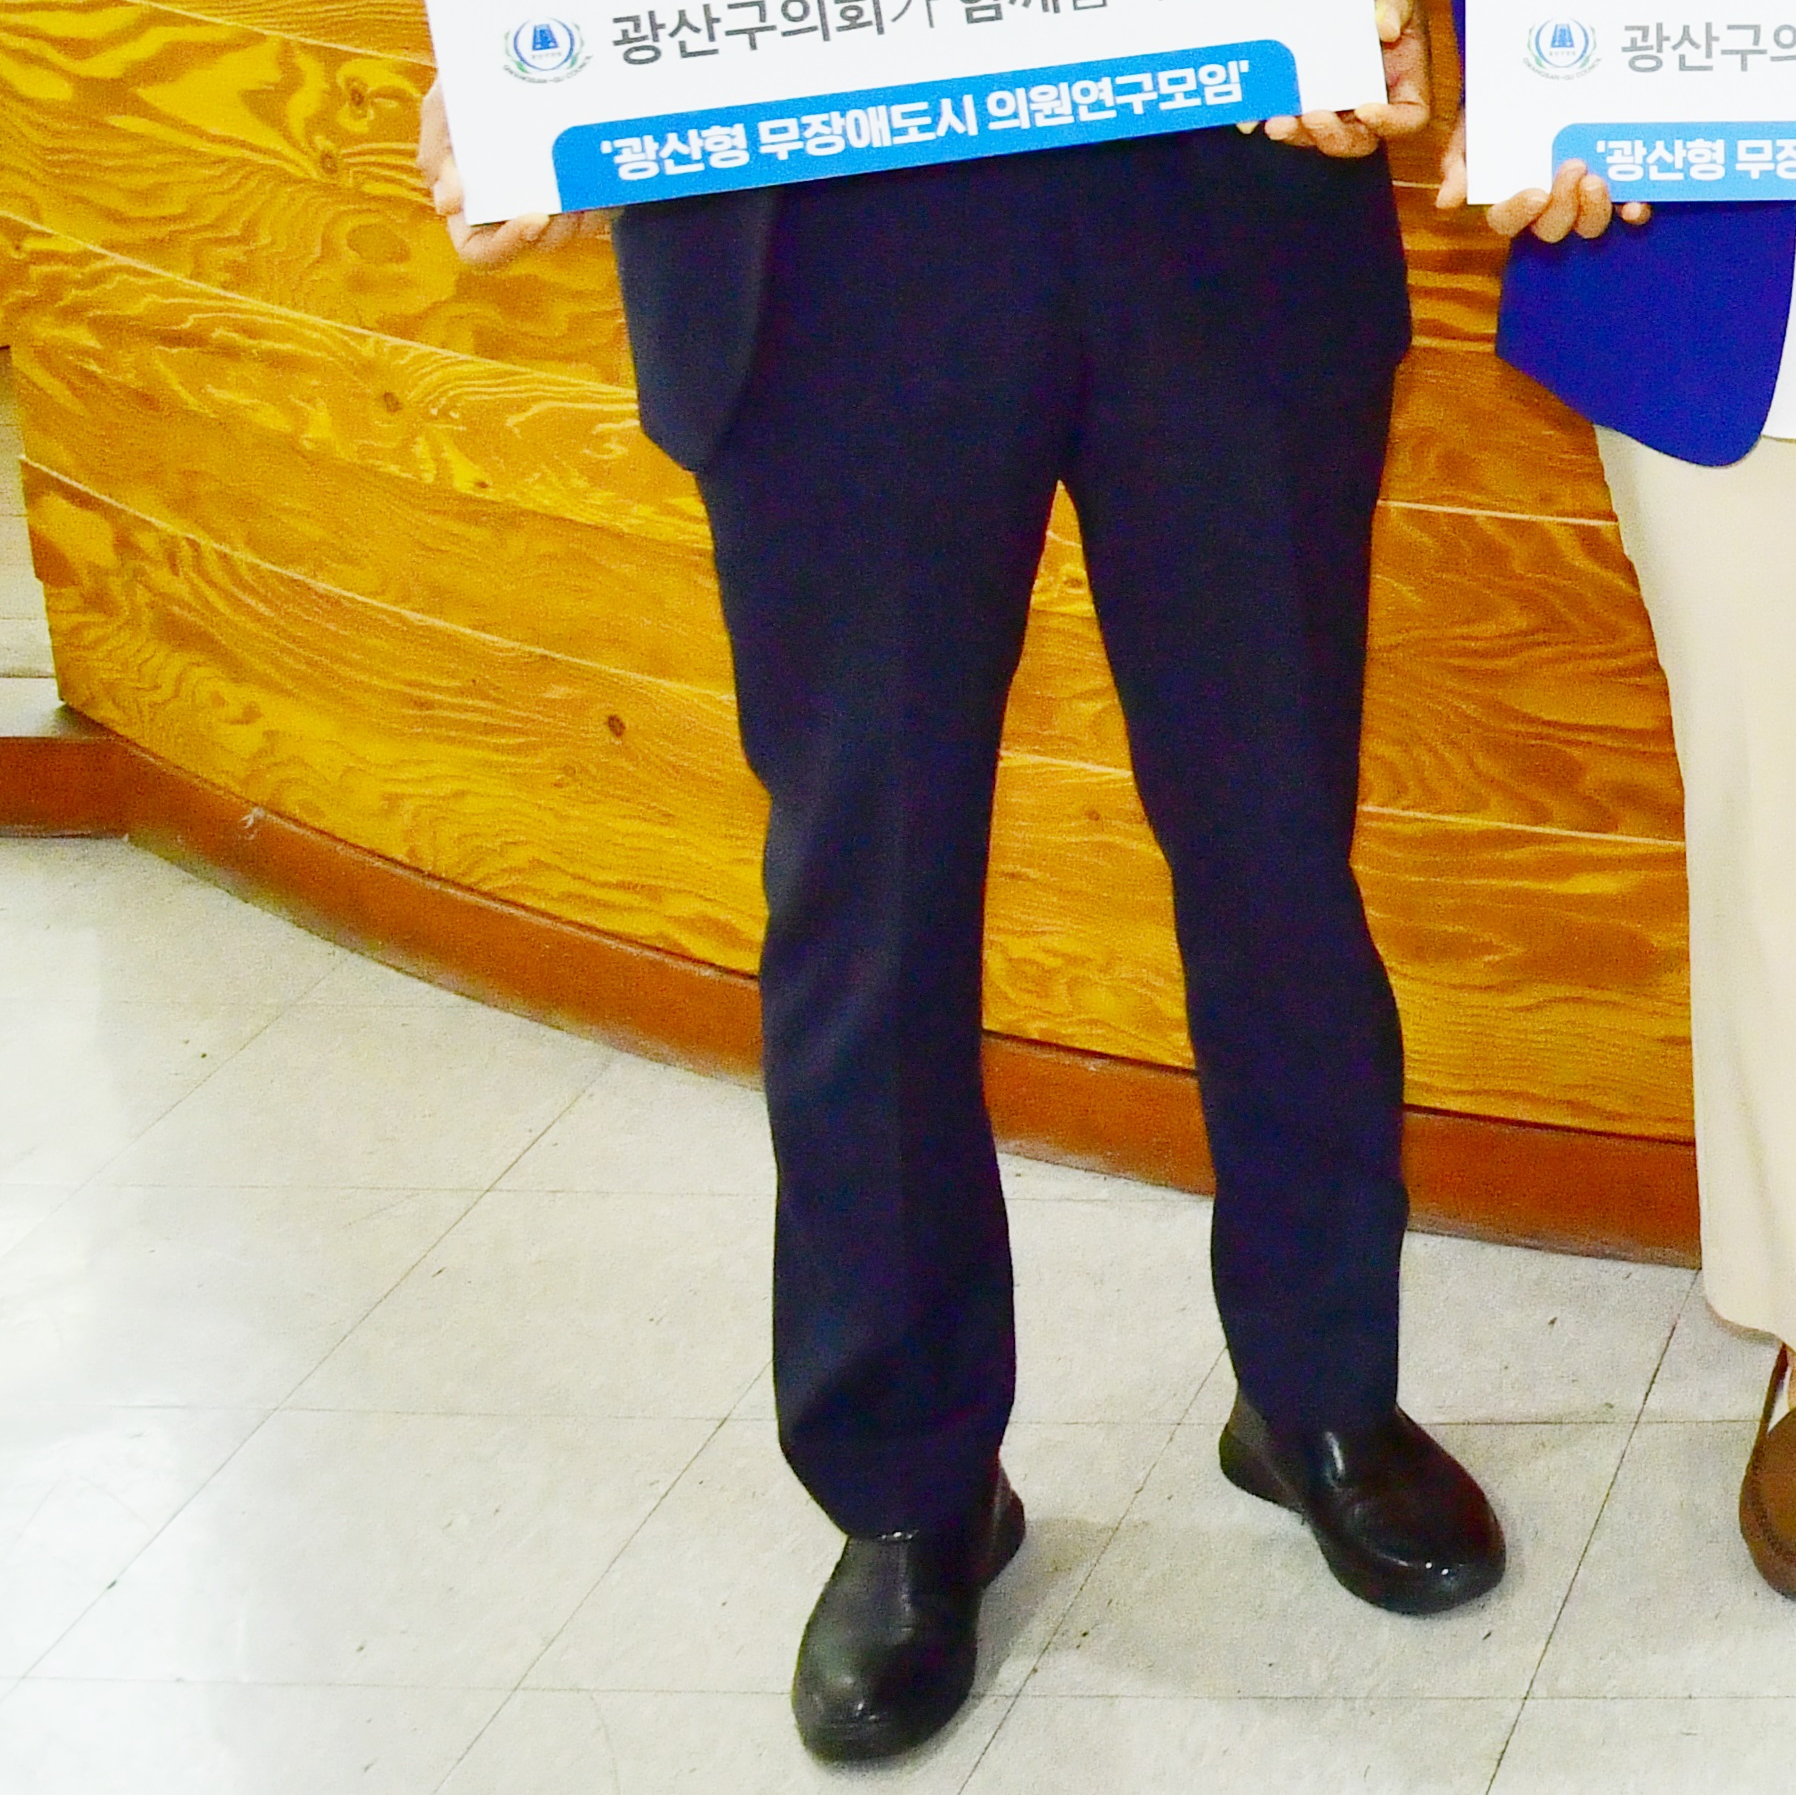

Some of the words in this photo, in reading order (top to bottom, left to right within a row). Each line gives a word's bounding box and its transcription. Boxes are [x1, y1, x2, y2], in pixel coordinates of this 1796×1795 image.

[600, 123, 750, 181] '광산형
[757, 94, 979, 161] 무장애도시
[984, 58, 1253, 135] 의원연구모임'
[1596, 138, 1726, 182] '광산형
